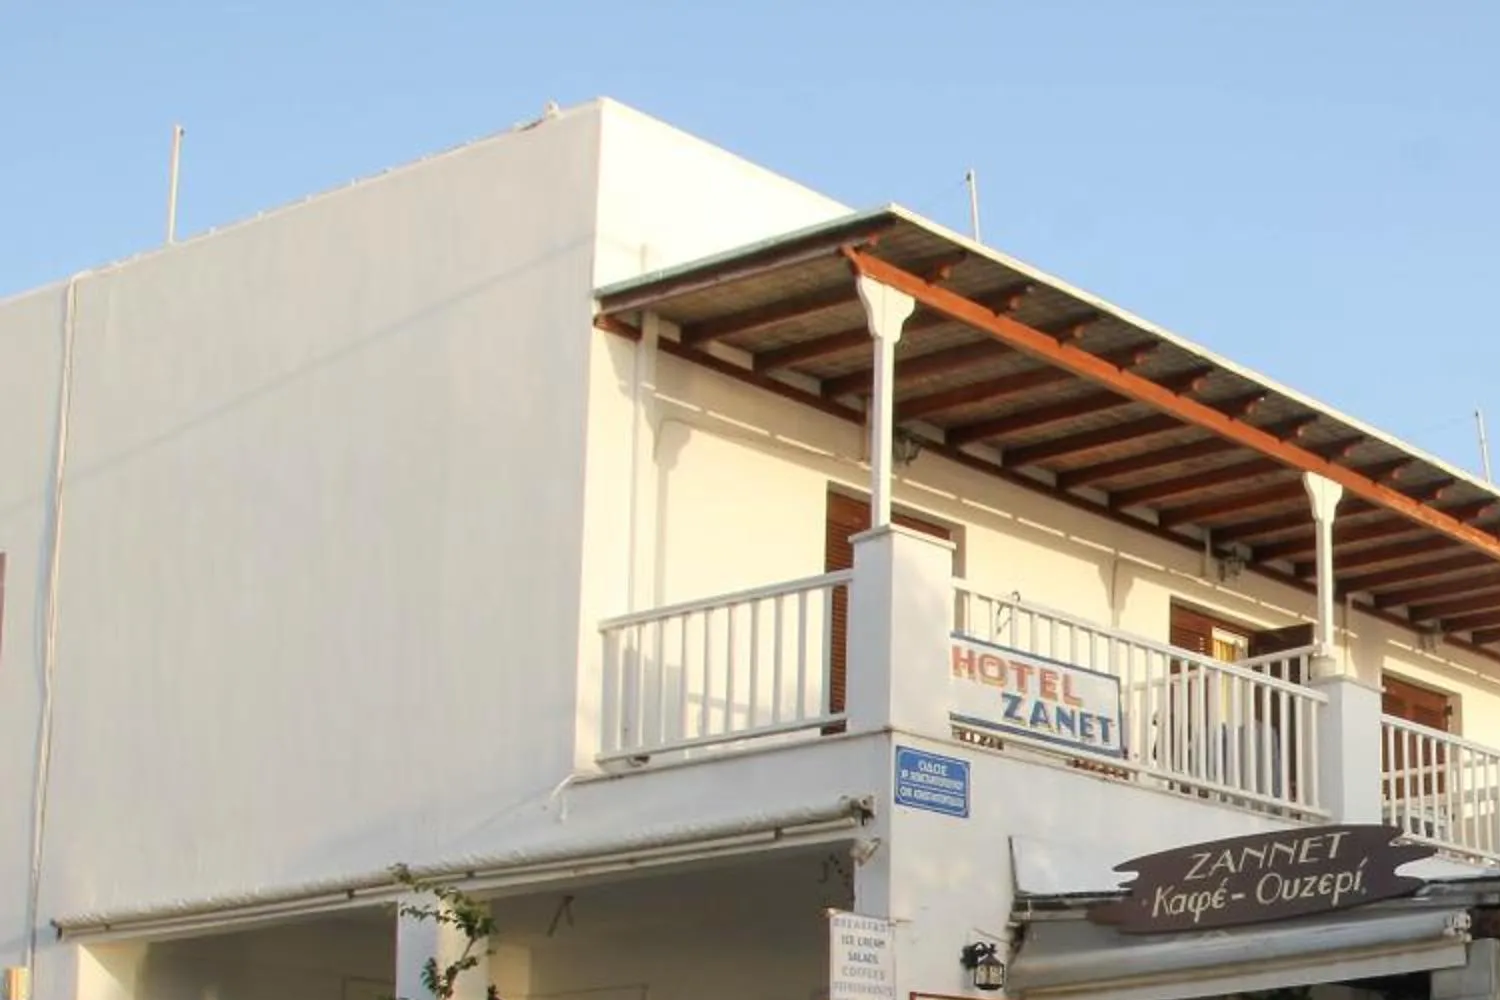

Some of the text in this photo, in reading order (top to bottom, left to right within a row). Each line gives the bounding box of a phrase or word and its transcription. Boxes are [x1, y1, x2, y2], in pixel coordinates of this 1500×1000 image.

[952, 645, 1082, 708] HOTEL
[1001, 692, 1114, 746] ZANET
[1184, 831, 1350, 881] ZANNET
